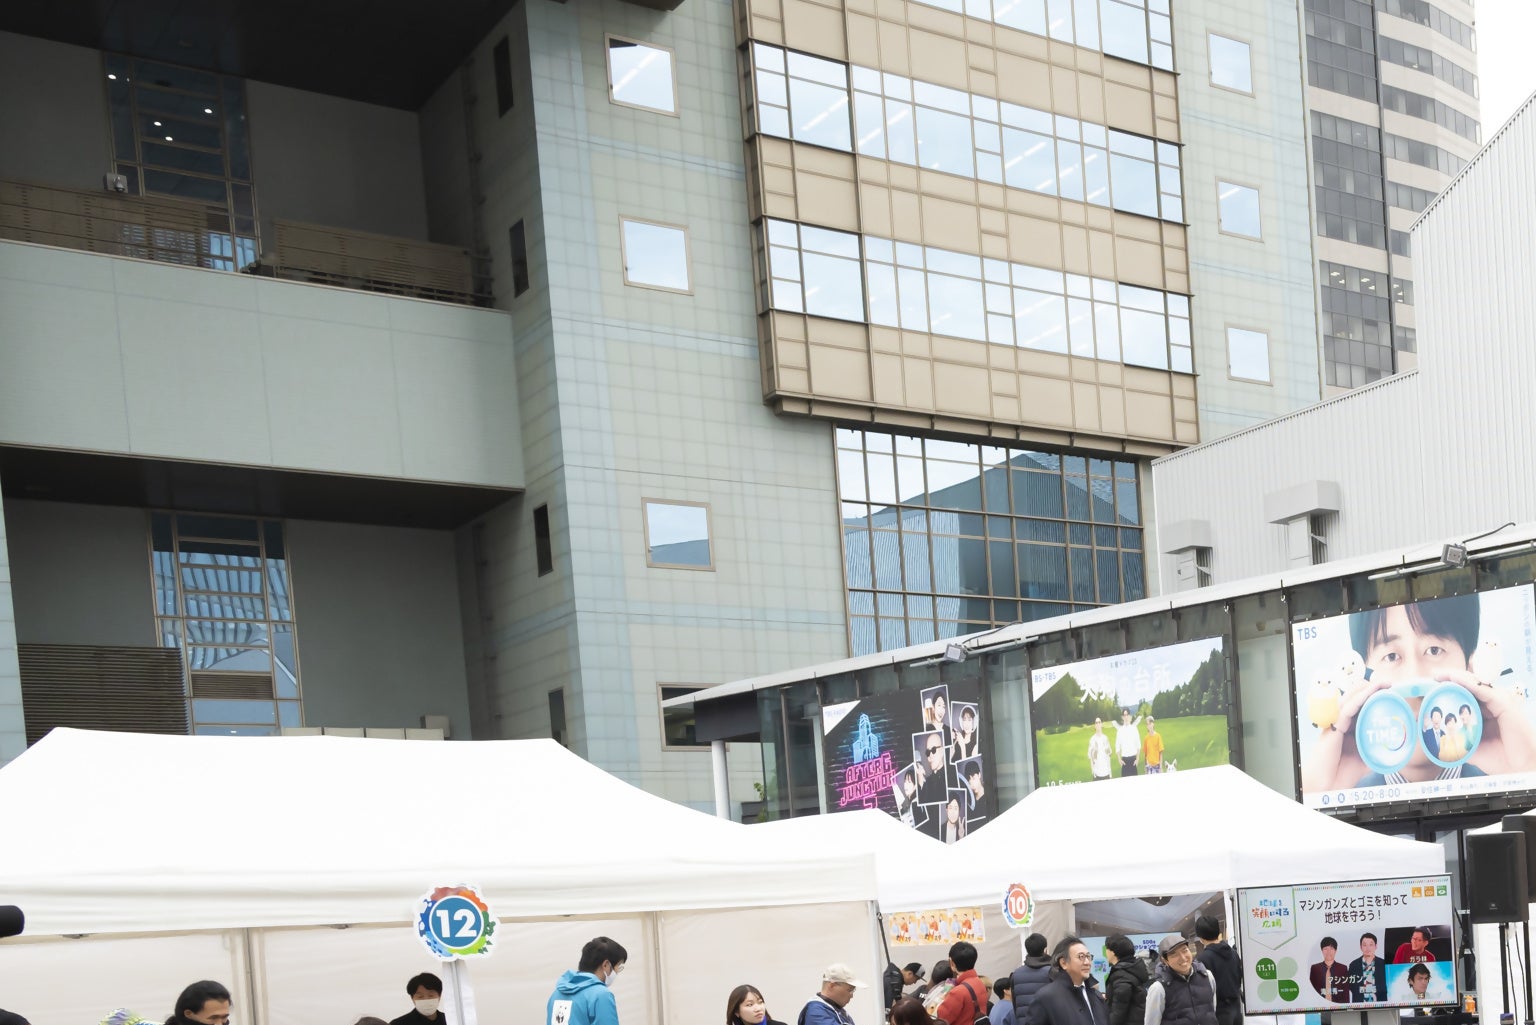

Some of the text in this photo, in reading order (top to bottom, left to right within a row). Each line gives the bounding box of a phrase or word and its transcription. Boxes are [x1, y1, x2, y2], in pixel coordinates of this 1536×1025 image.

[1297, 627, 1317, 641] TBS
[1010, 896, 1026, 915] 10
[1299, 894, 1408, 911] マシンガンズとゴミを知って
[436, 908, 478, 938] 12
[1325, 909, 1382, 923] 地球を守ろう！
[1257, 964, 1275, 972] 11.11
